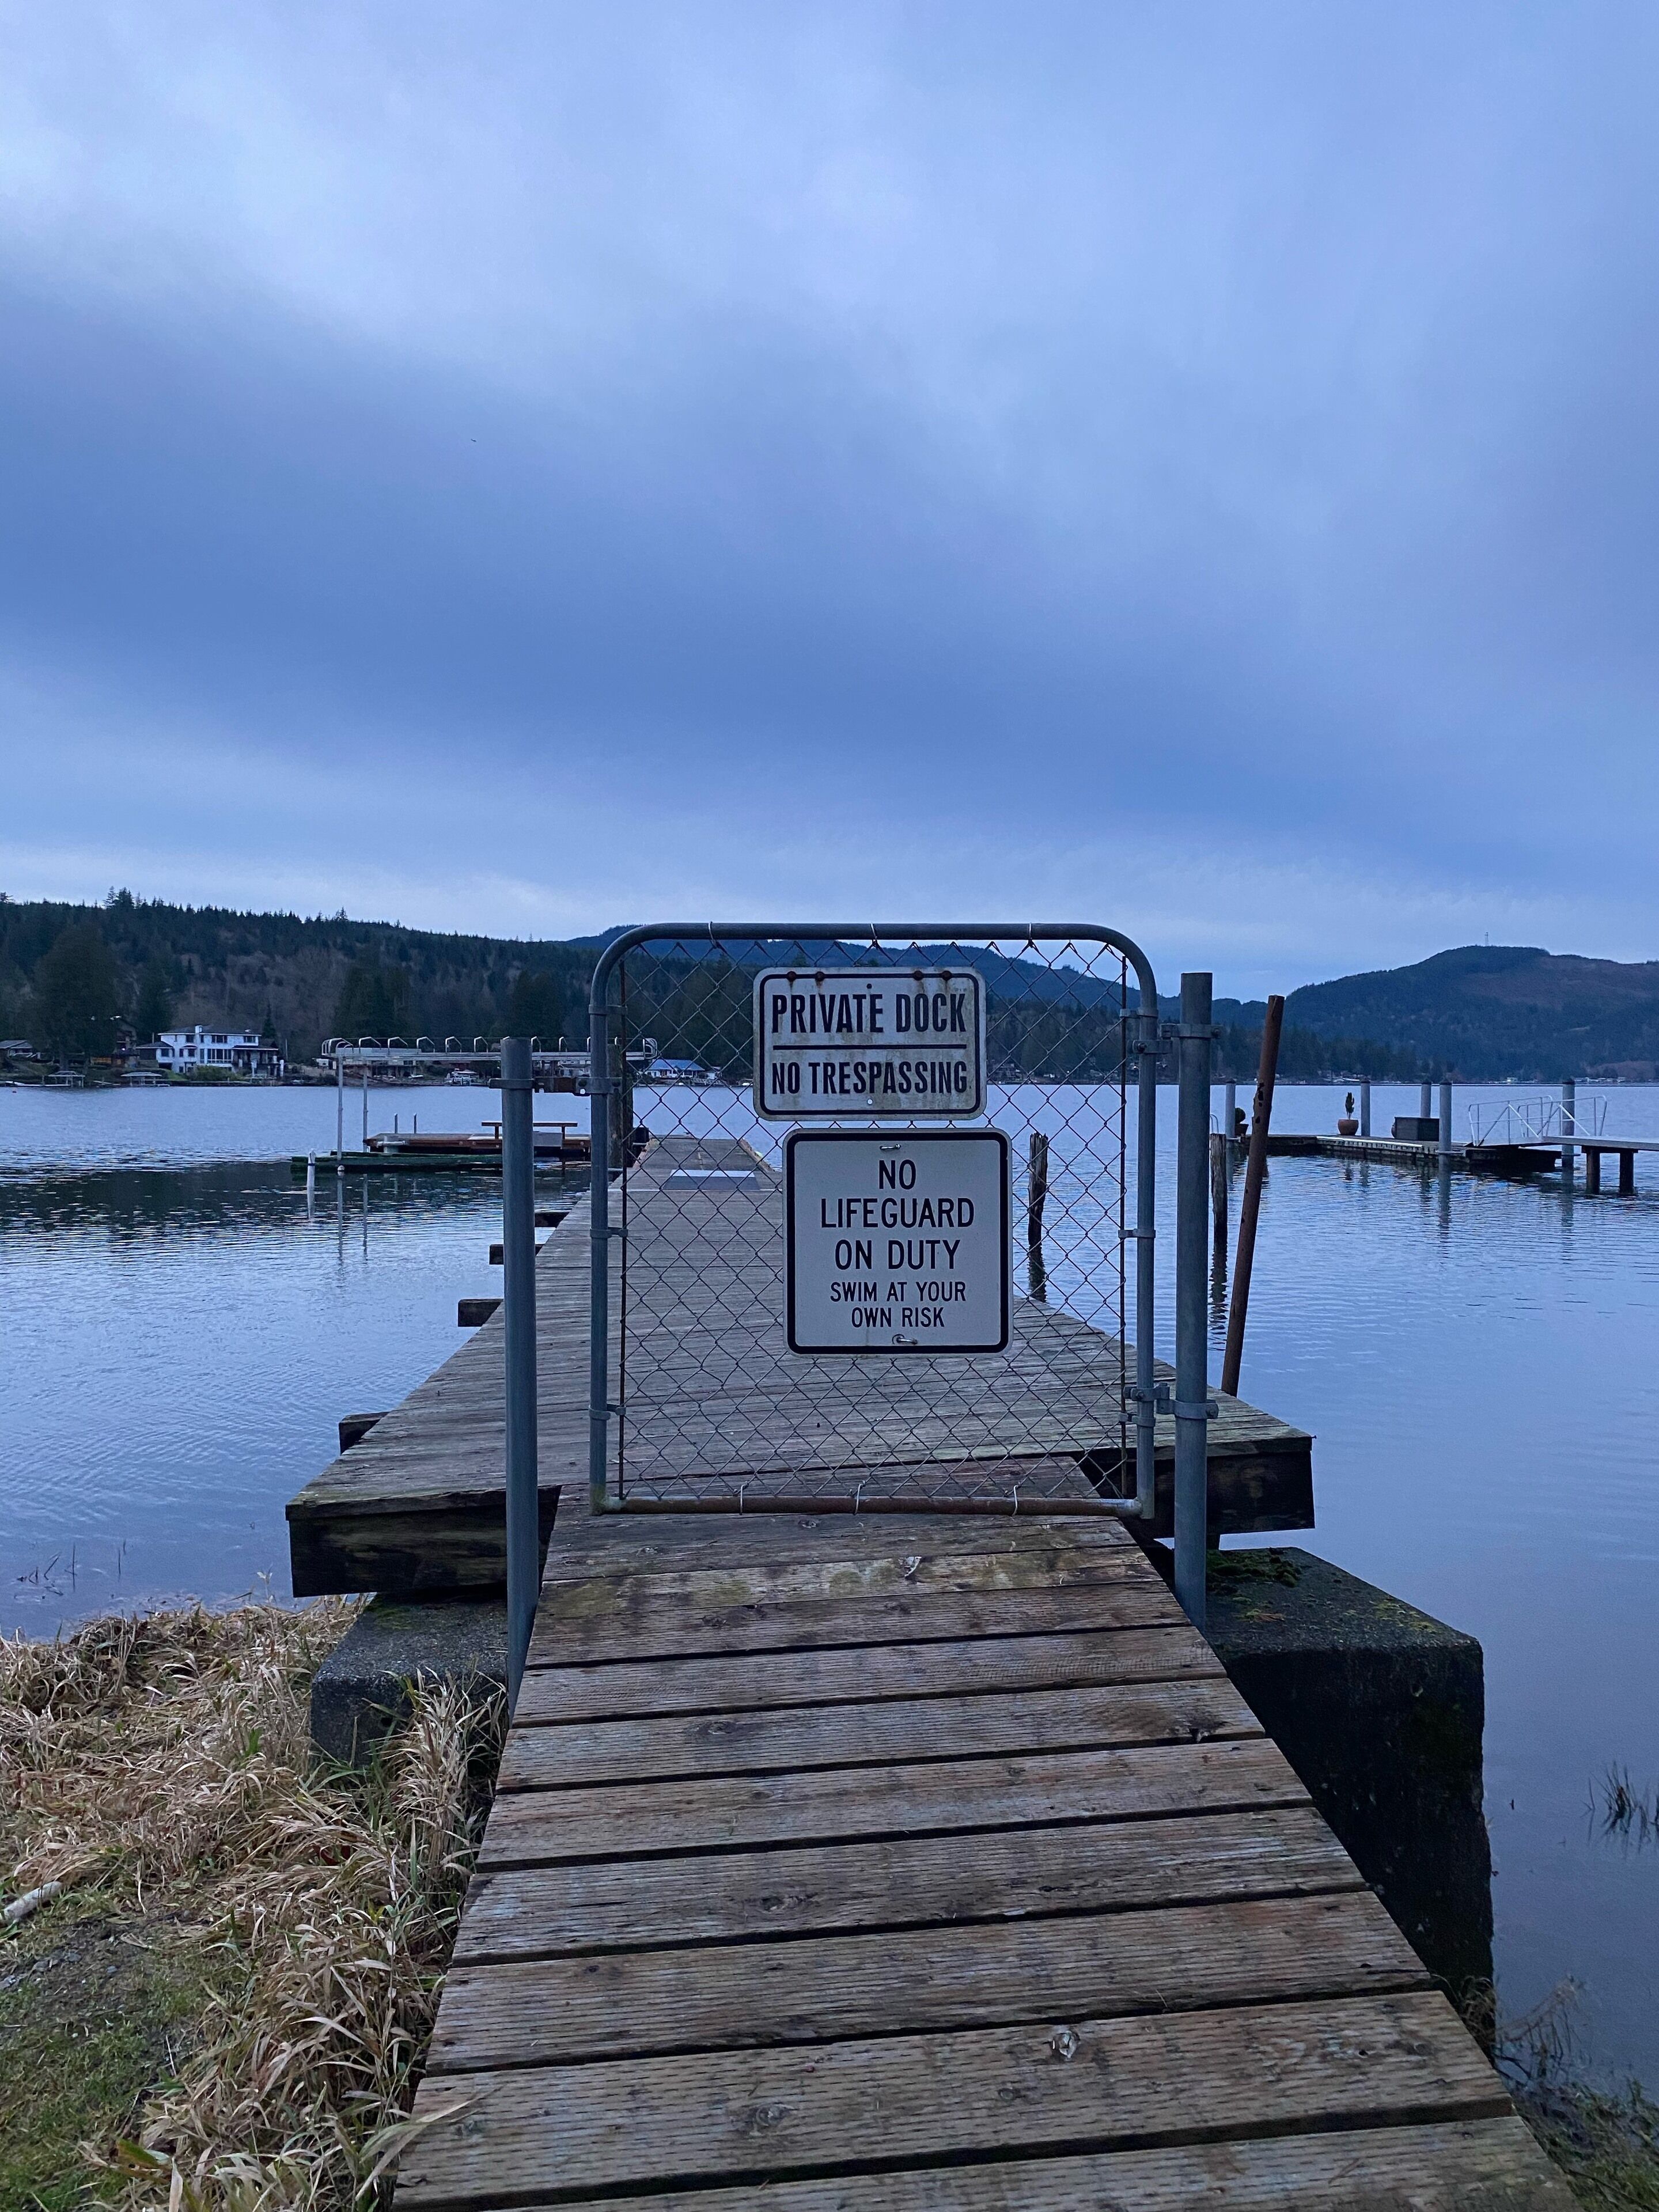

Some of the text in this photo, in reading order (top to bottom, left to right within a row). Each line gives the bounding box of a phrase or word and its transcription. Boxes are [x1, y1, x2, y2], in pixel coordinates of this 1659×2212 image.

[772, 993, 967, 1033] PRIVATE DOCK
[772, 1061, 967, 1094] NO TRESPASSING
[878, 1159, 916, 1190] NO
[821, 1198, 975, 1228] LIFEGUARD
[835, 1239, 961, 1270] ON DUTY
[830, 1281, 966, 1302] SWIM AT YOUR
[851, 1306, 945, 1328] OWN RISK
